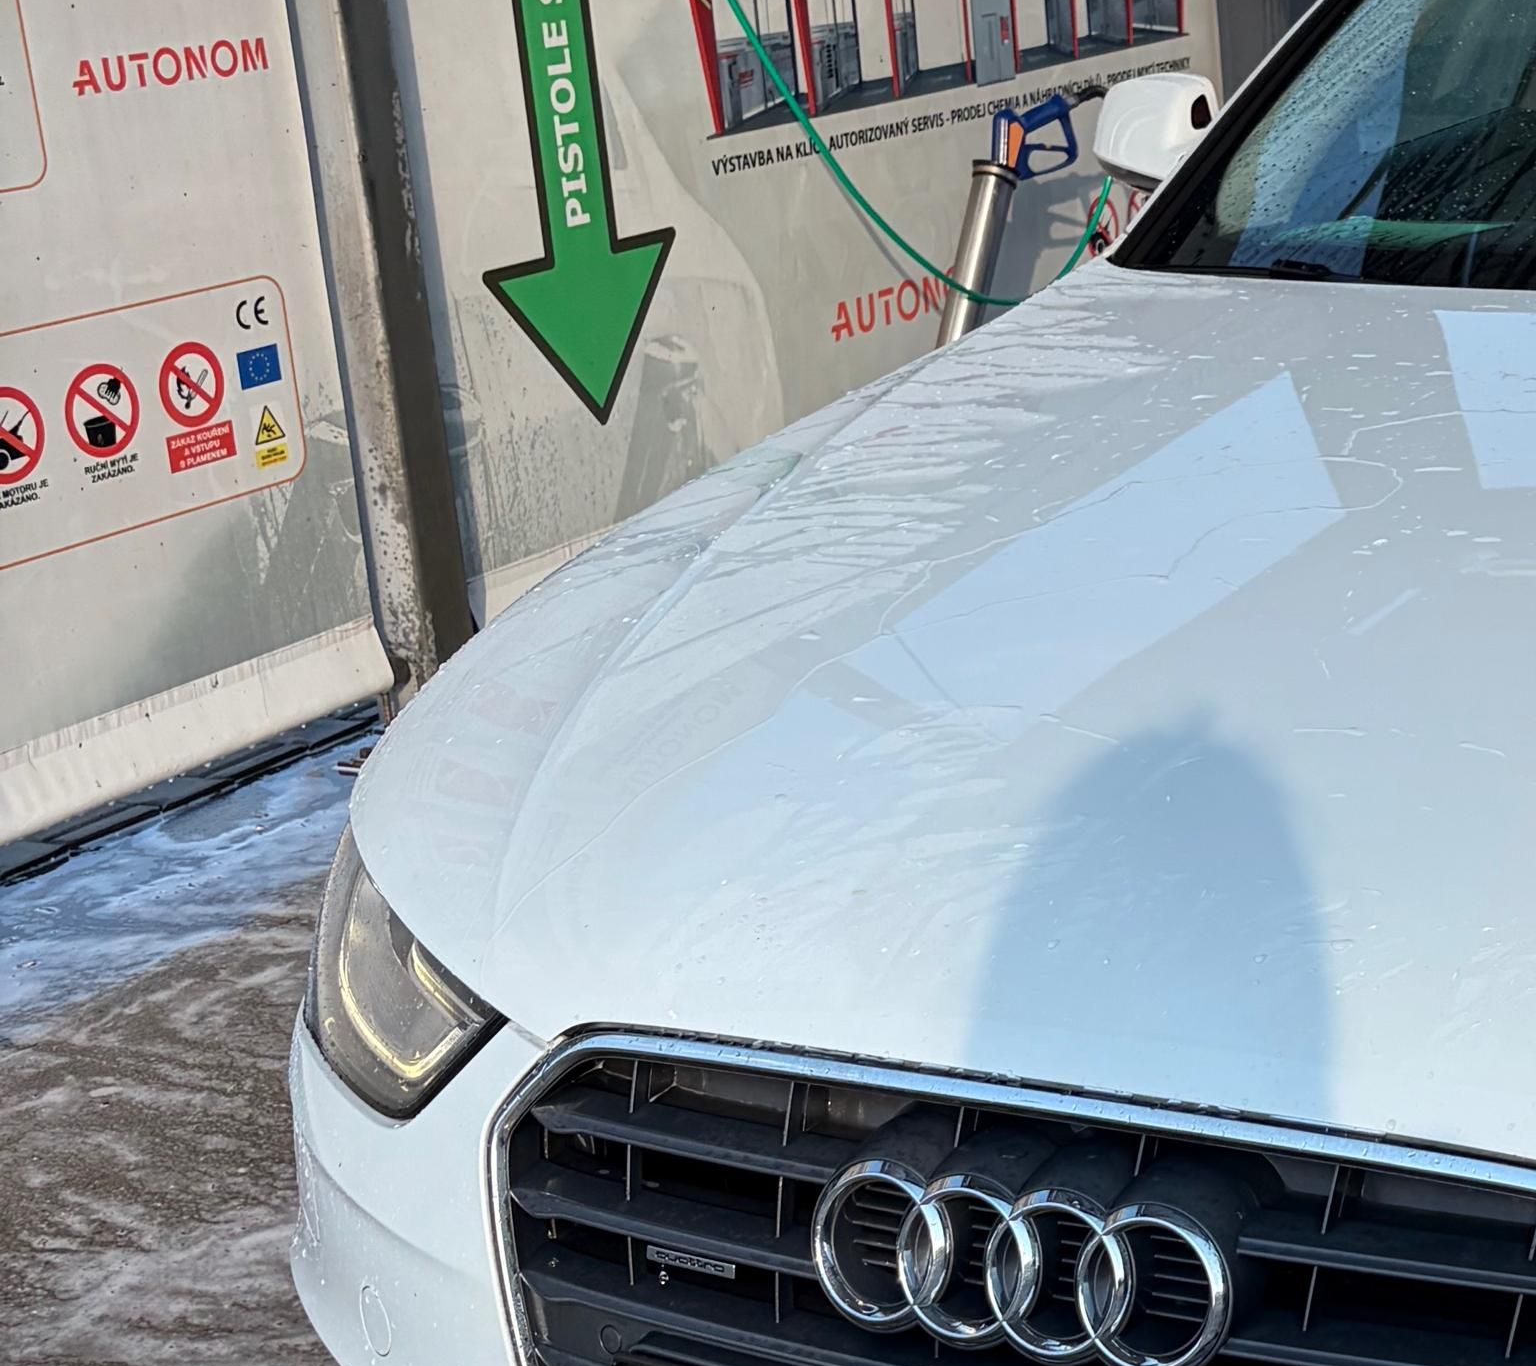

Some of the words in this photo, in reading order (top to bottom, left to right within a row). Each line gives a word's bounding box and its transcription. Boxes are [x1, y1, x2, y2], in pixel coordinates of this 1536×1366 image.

[72, 37, 269, 96] AUTONOM
[542, 19, 592, 228] PISTOLE
[712, 147, 775, 176] VÝSTAVBA
[776, 144, 794, 163] NA
[828, 117, 909, 152] AUTORIZOVANÝ
[911, 111, 945, 133] SERVIS
[951, 103, 986, 125] PRODEJ
[831, 266, 955, 342] AUTON
[171, 434, 196, 449] ZÁKAZ
[197, 423, 230, 442] KOUŘENÍ
[190, 439, 220, 454] VSTUPU
[84, 460, 109, 475] RUČNÍ
[187, 448, 228, 467] PLAMENEM
[2, 483, 37, 498] MOTORU
[655, 1251, 724, 1273] quattro
